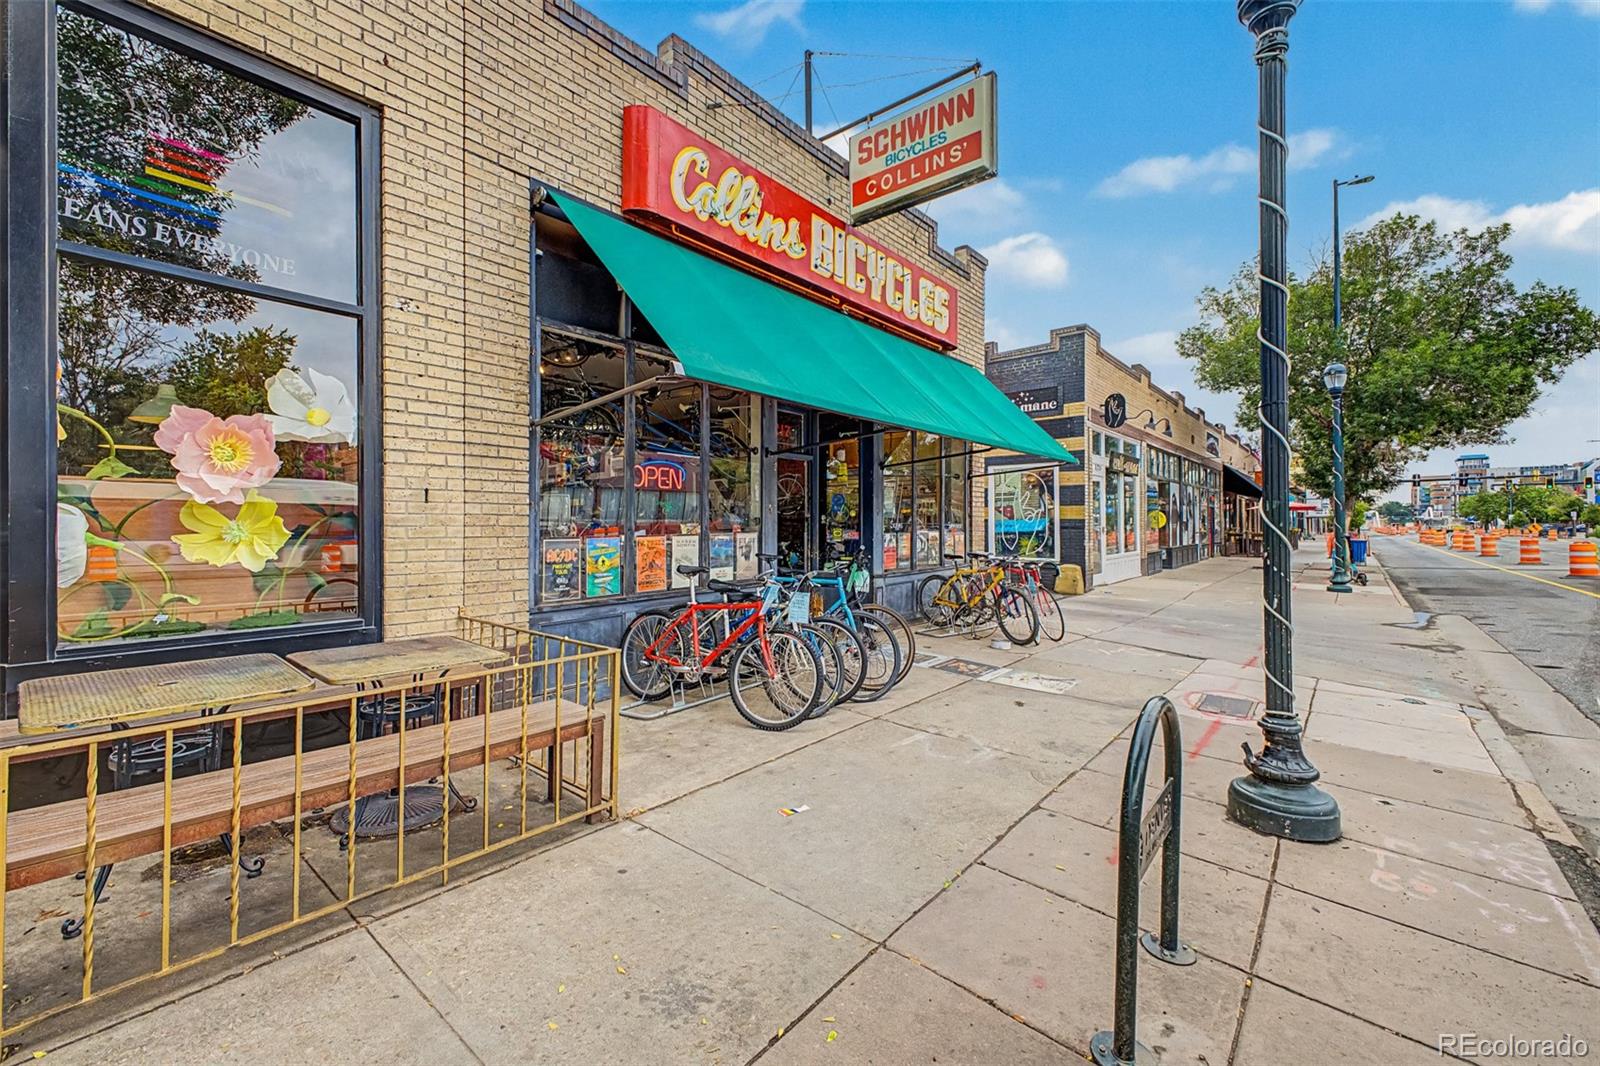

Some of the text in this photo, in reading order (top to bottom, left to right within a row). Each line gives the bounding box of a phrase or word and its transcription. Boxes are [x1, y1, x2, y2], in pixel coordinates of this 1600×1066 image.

[857, 87, 975, 166] SCHWINN
[885, 131, 948, 167] BICYCLES
[865, 142, 968, 196] COLLINS'
[57, 195, 297, 276] EANS EVERYONE
[670, 146, 950, 334] Collins BICYCLES
[633, 464, 683, 490] OPEN
